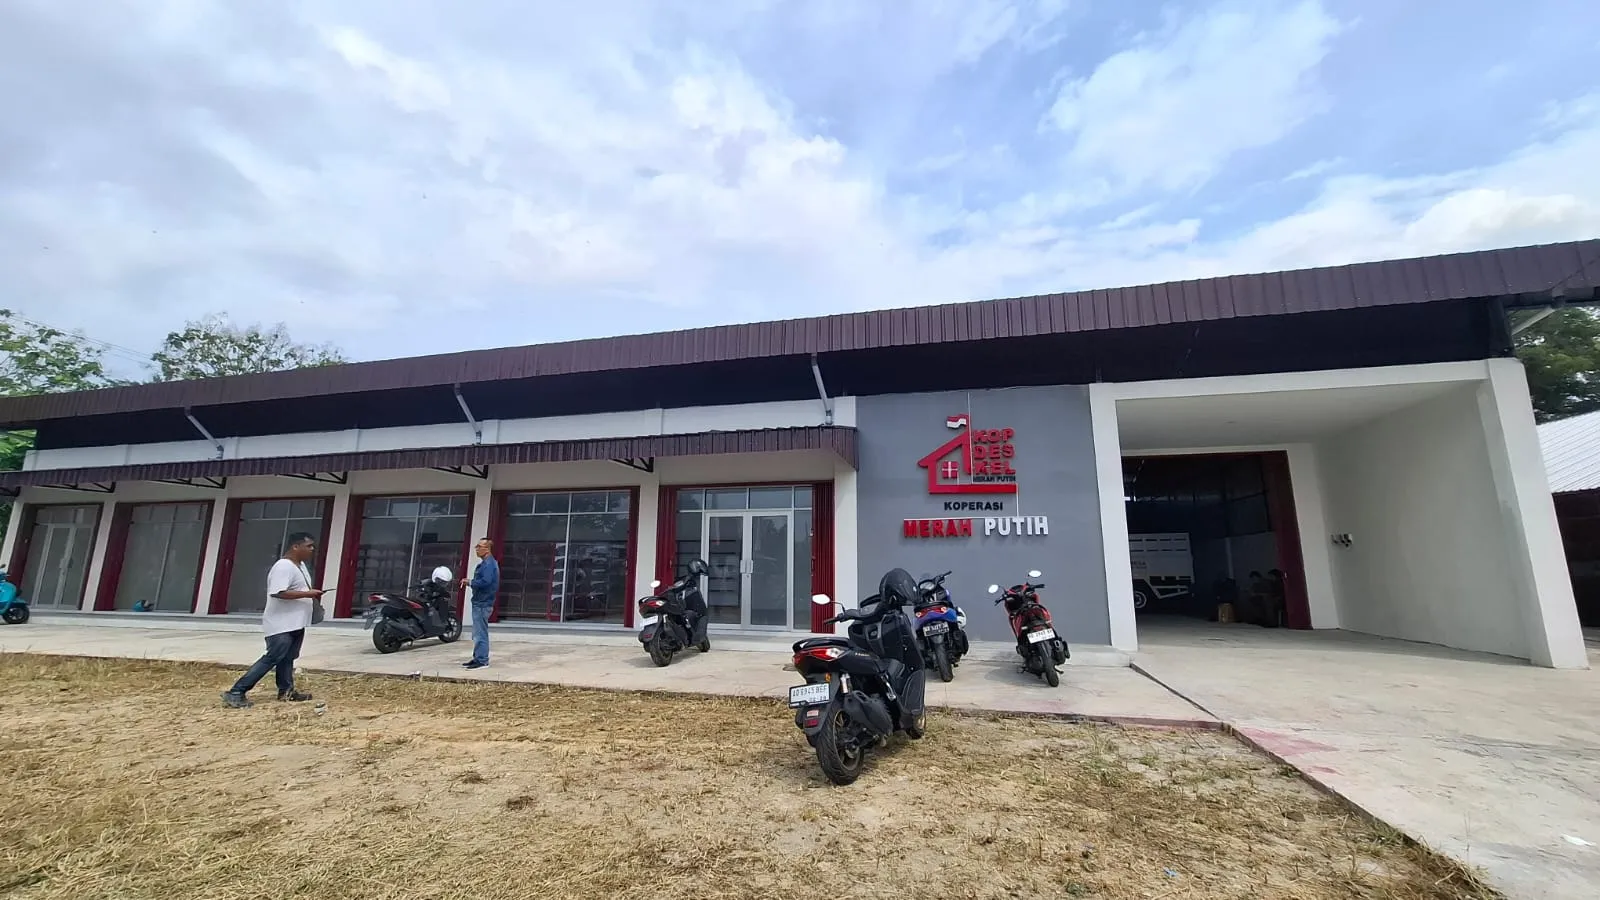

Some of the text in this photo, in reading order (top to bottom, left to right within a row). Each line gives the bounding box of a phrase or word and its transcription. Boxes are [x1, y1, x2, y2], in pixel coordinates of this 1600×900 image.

[973, 428, 1014, 443] KOP
[974, 444, 1014, 460] DES
[974, 460, 1016, 475] KEL
[944, 501, 1003, 511] KOPERASI
[904, 517, 1049, 537] MERAH PUTIH
